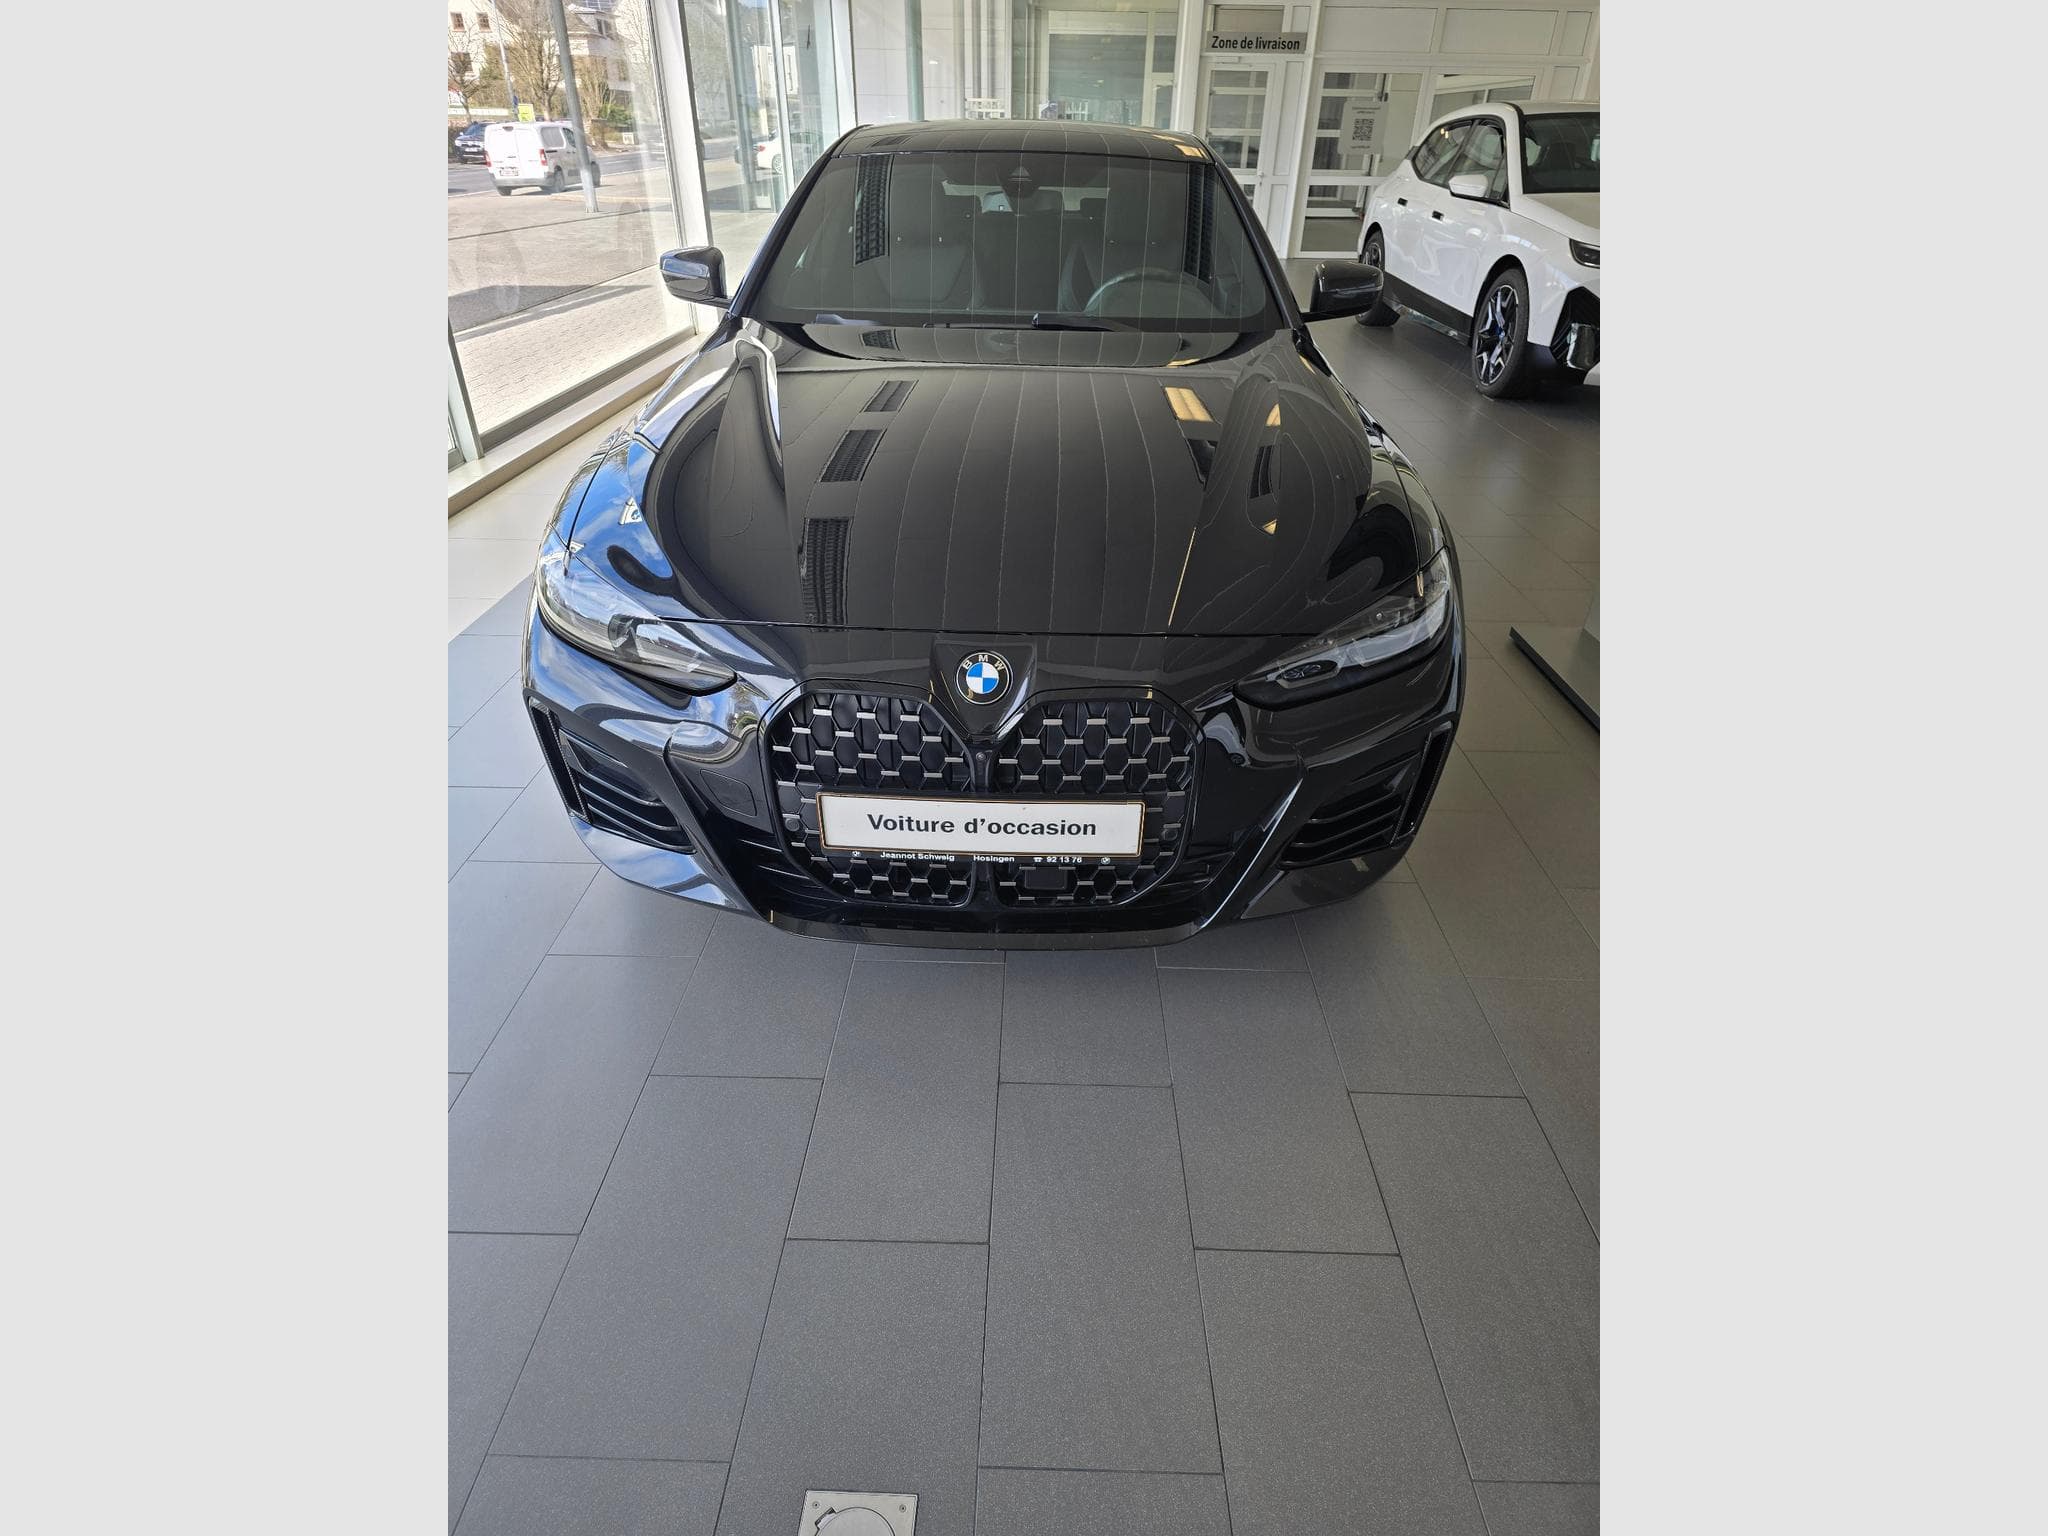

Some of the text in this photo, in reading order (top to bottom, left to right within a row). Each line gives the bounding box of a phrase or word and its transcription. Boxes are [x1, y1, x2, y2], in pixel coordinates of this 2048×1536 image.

[1211, 35, 1300, 50] Zone de livraison
[962, 654, 1005, 671] BMW
[867, 813, 1097, 836] Voiture d'occasion
[880, 851, 915, 860] Jeannot
[973, 855, 1015, 863] Hosingen
